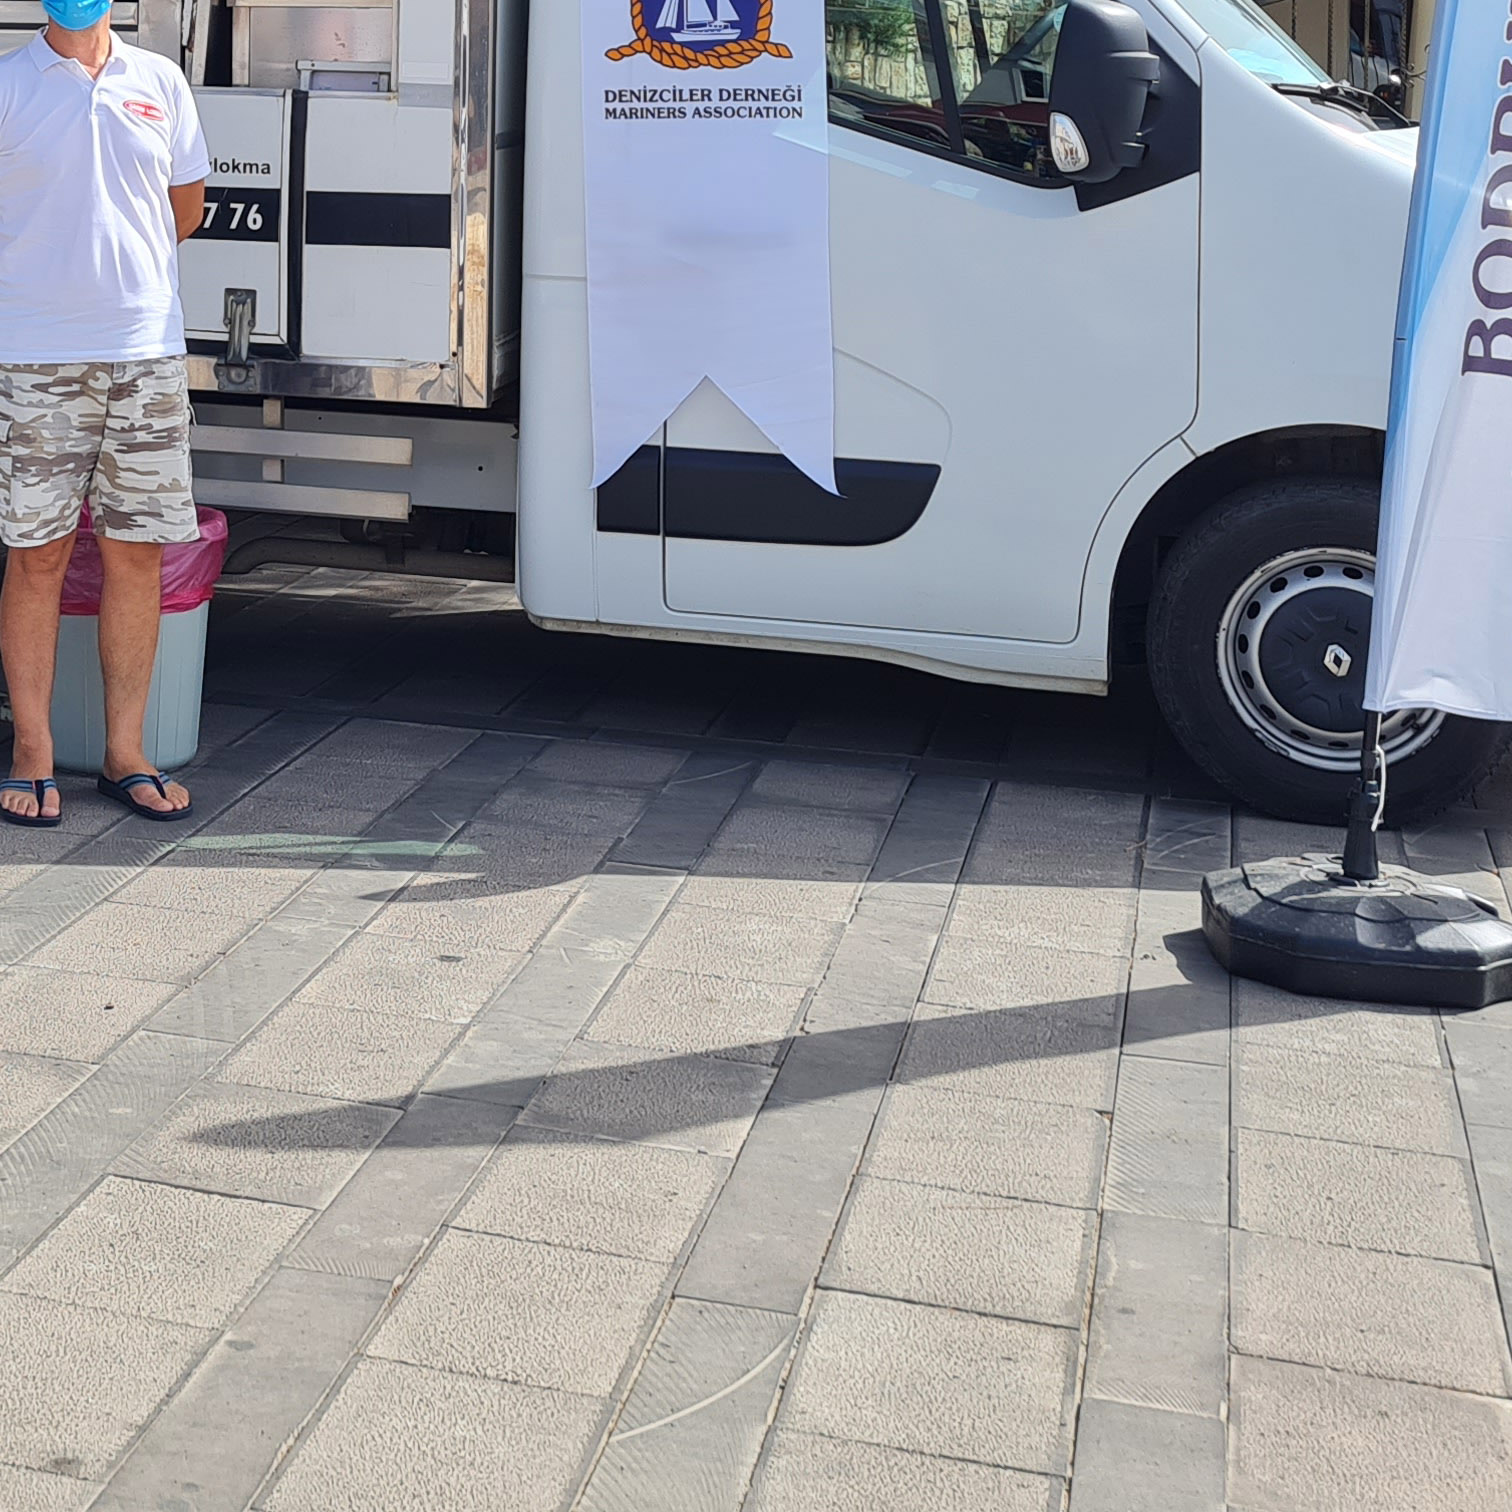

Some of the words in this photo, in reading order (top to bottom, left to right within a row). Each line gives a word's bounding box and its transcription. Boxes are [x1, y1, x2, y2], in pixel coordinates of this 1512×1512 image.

[604, 85, 713, 103] DENİZCİLER
[718, 84, 802, 102] DERNEĞİ
[604, 106, 687, 120] MARINERS
[691, 106, 803, 119] ASSOCIATION
[229, 202, 263, 231] 76
